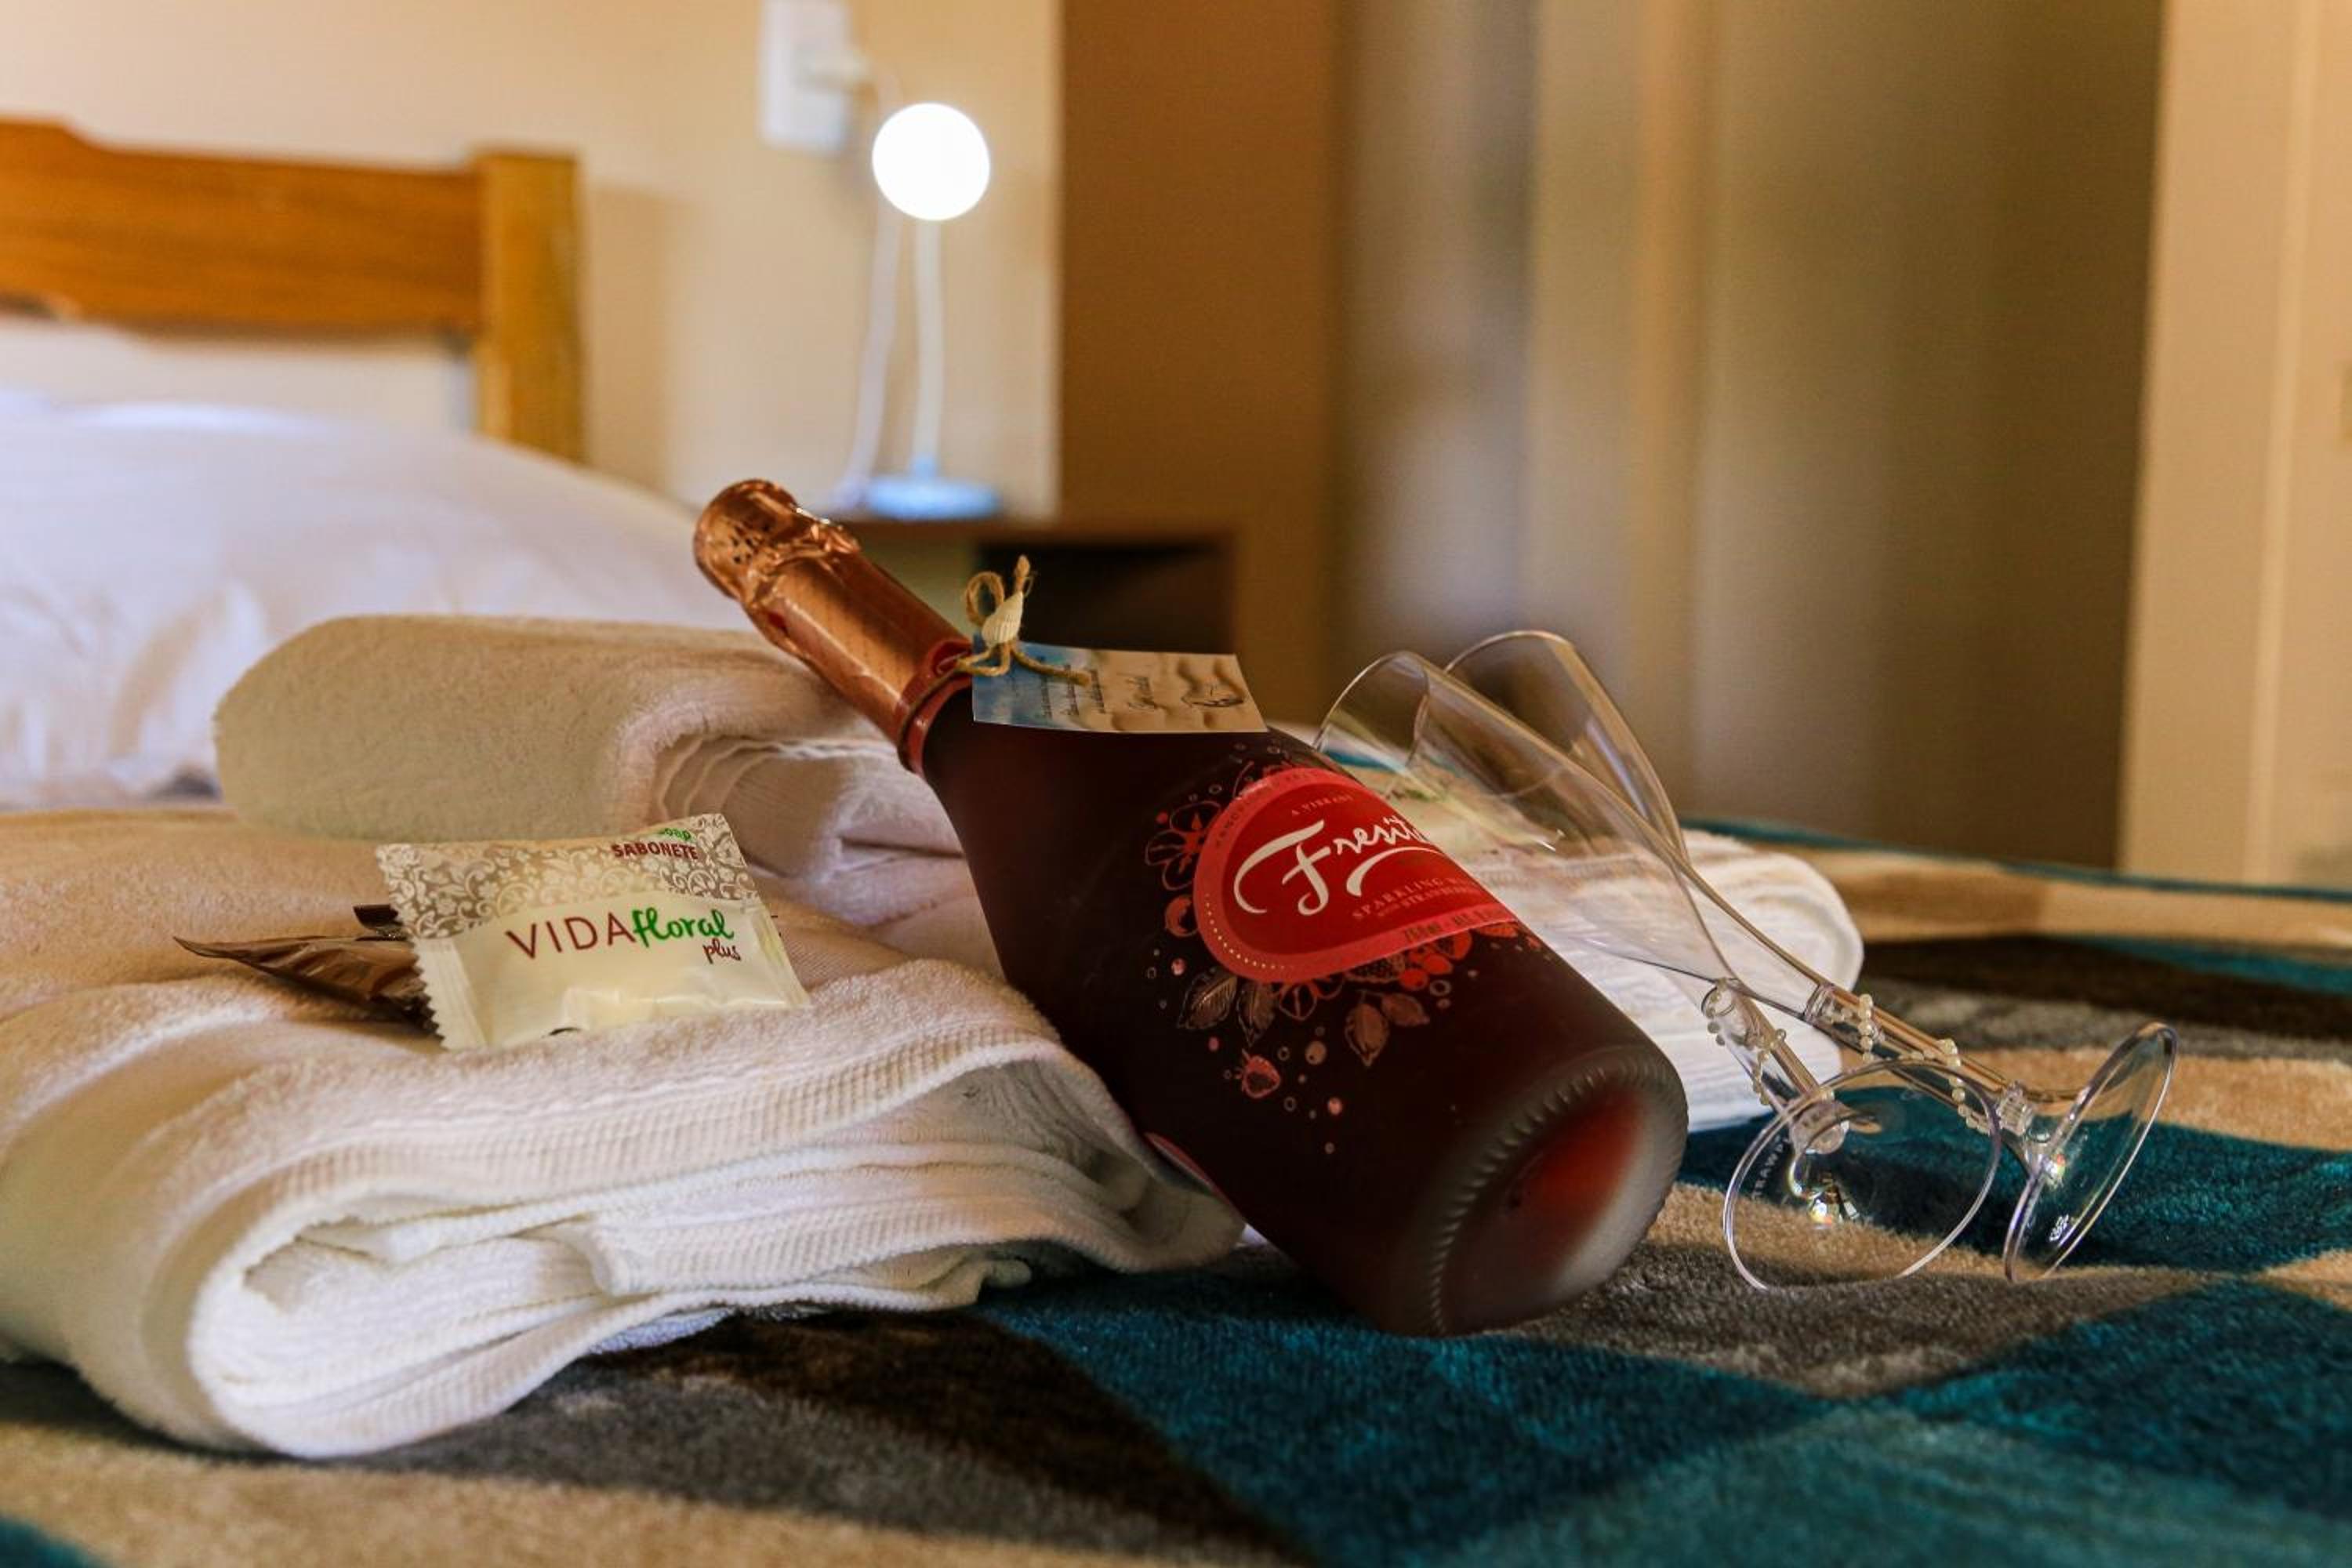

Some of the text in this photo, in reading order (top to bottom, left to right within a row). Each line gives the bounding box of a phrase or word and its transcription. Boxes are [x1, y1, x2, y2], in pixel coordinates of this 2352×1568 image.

[611, 841, 699, 860] SABONETE
[505, 906, 735, 960] VIDA floral
[702, 937, 742, 964] plus
